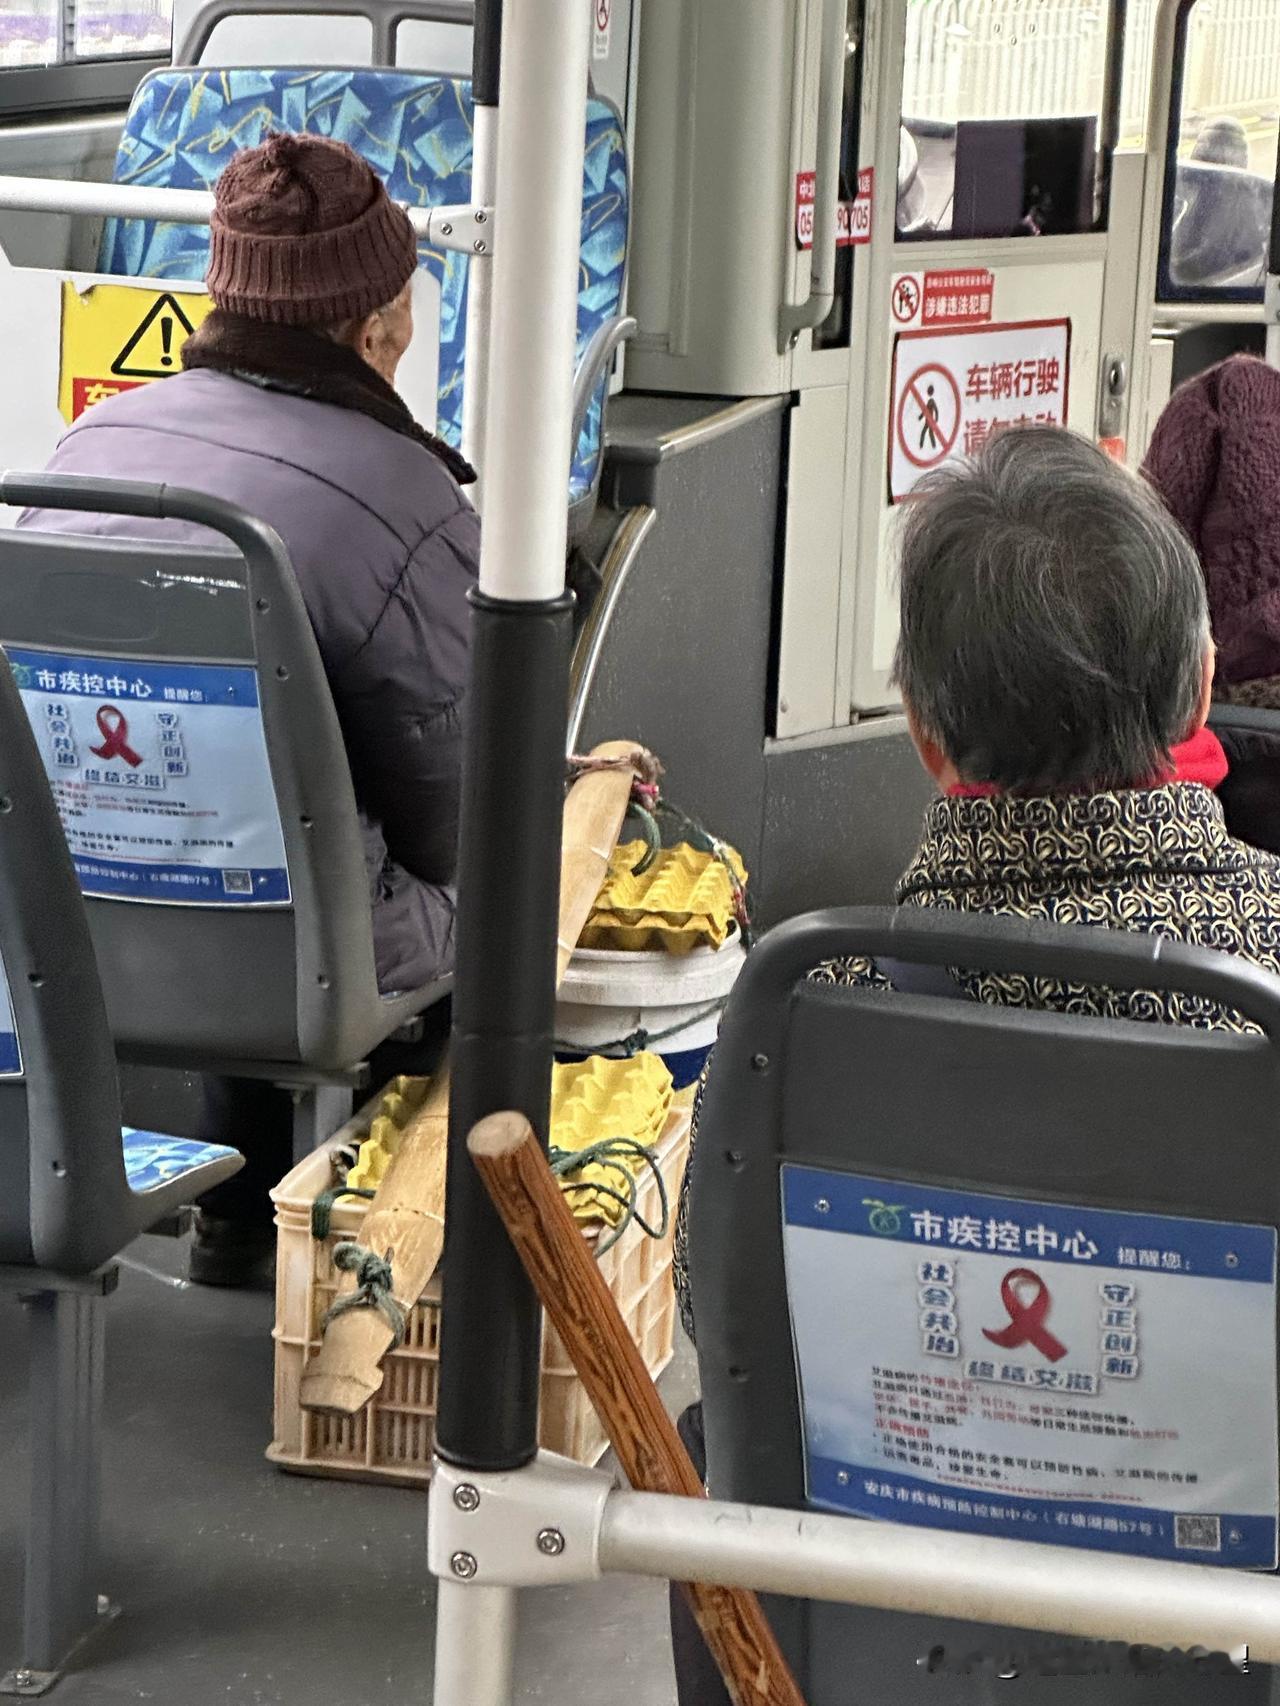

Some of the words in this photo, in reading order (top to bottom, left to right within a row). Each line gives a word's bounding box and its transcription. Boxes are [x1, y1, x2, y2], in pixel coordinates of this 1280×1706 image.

[966, 356, 1060, 402] 车辆行驶
[35, 668, 152, 698] 市疾控中心
[909, 1209, 1099, 1260] 市疾控中心
